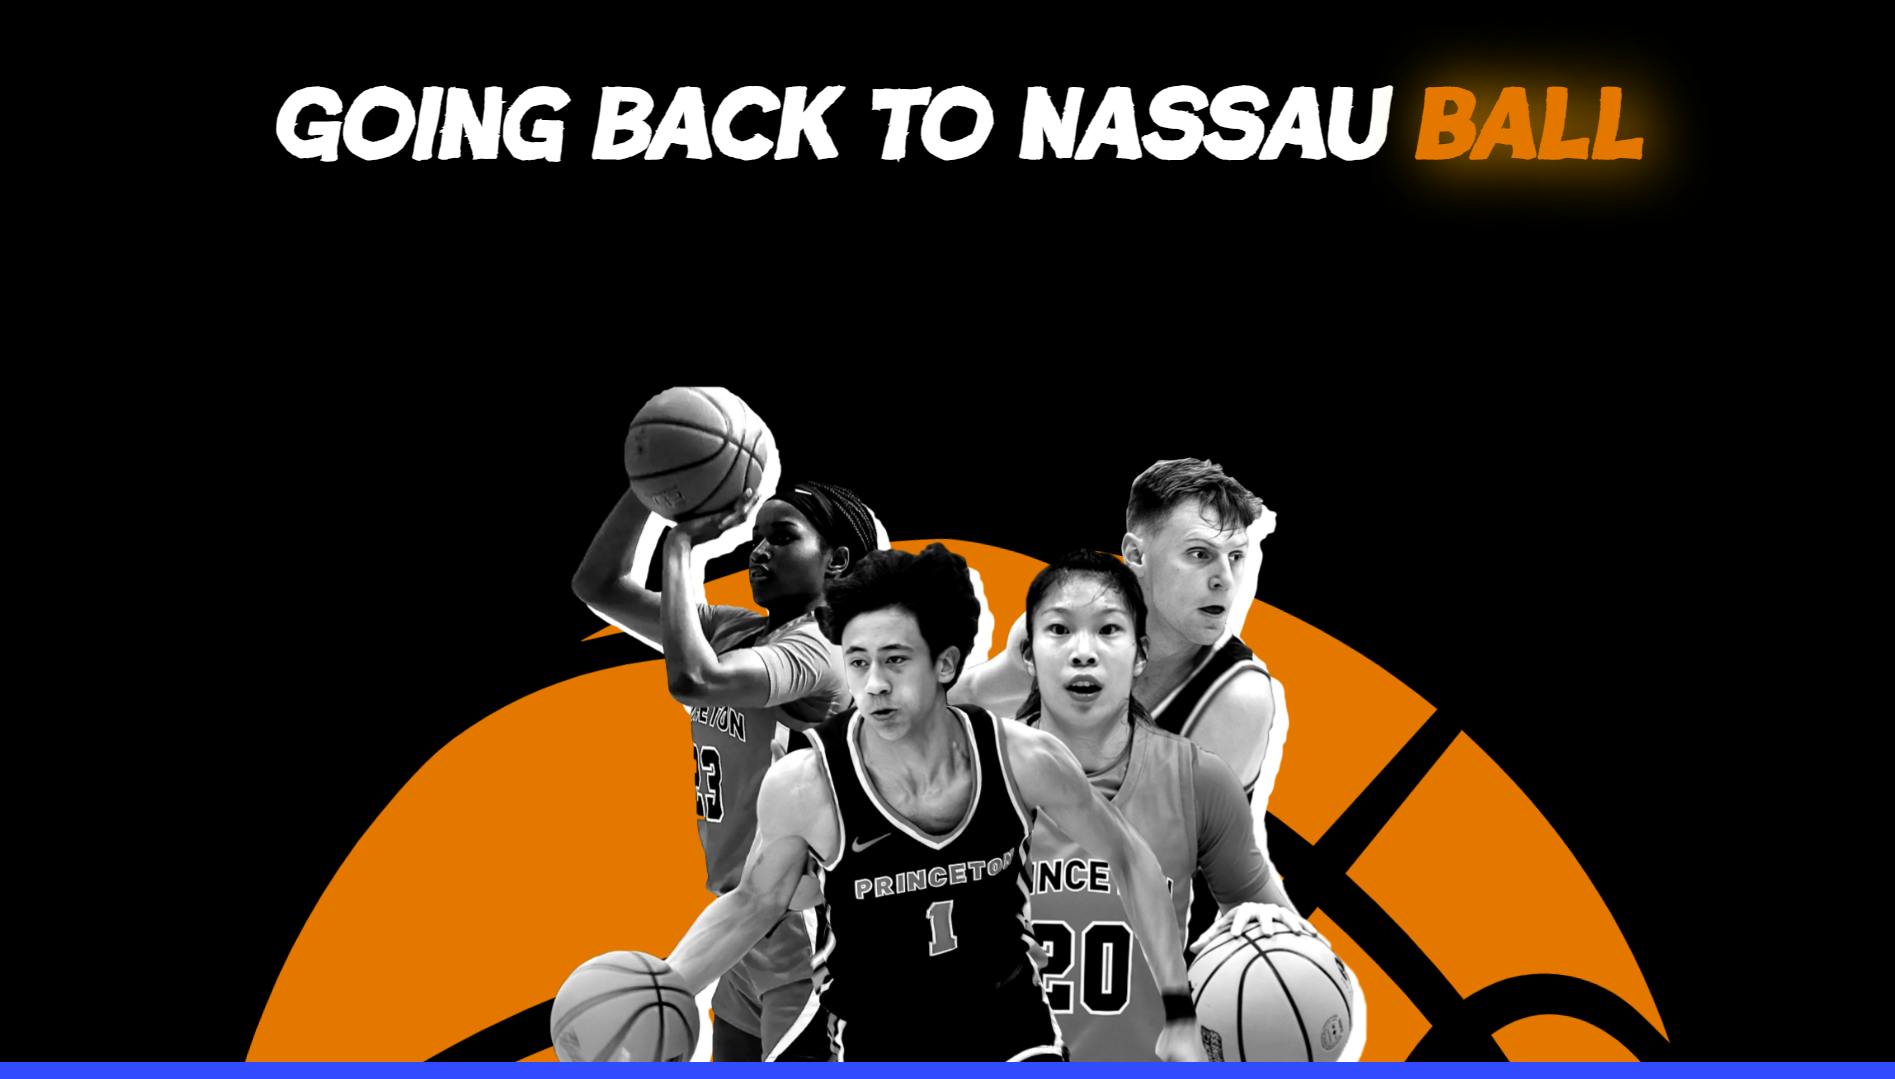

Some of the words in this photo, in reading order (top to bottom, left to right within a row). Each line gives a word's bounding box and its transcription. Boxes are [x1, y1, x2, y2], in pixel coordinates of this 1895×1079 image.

[277, 85, 570, 162] GOING
[592, 85, 845, 161] BACK
[872, 85, 993, 162] TO
[1019, 85, 1393, 161] NASSAU
[1415, 86, 1644, 160] BALL
[926, 899, 958, 957] 1
[1030, 919, 1134, 1015] 20
